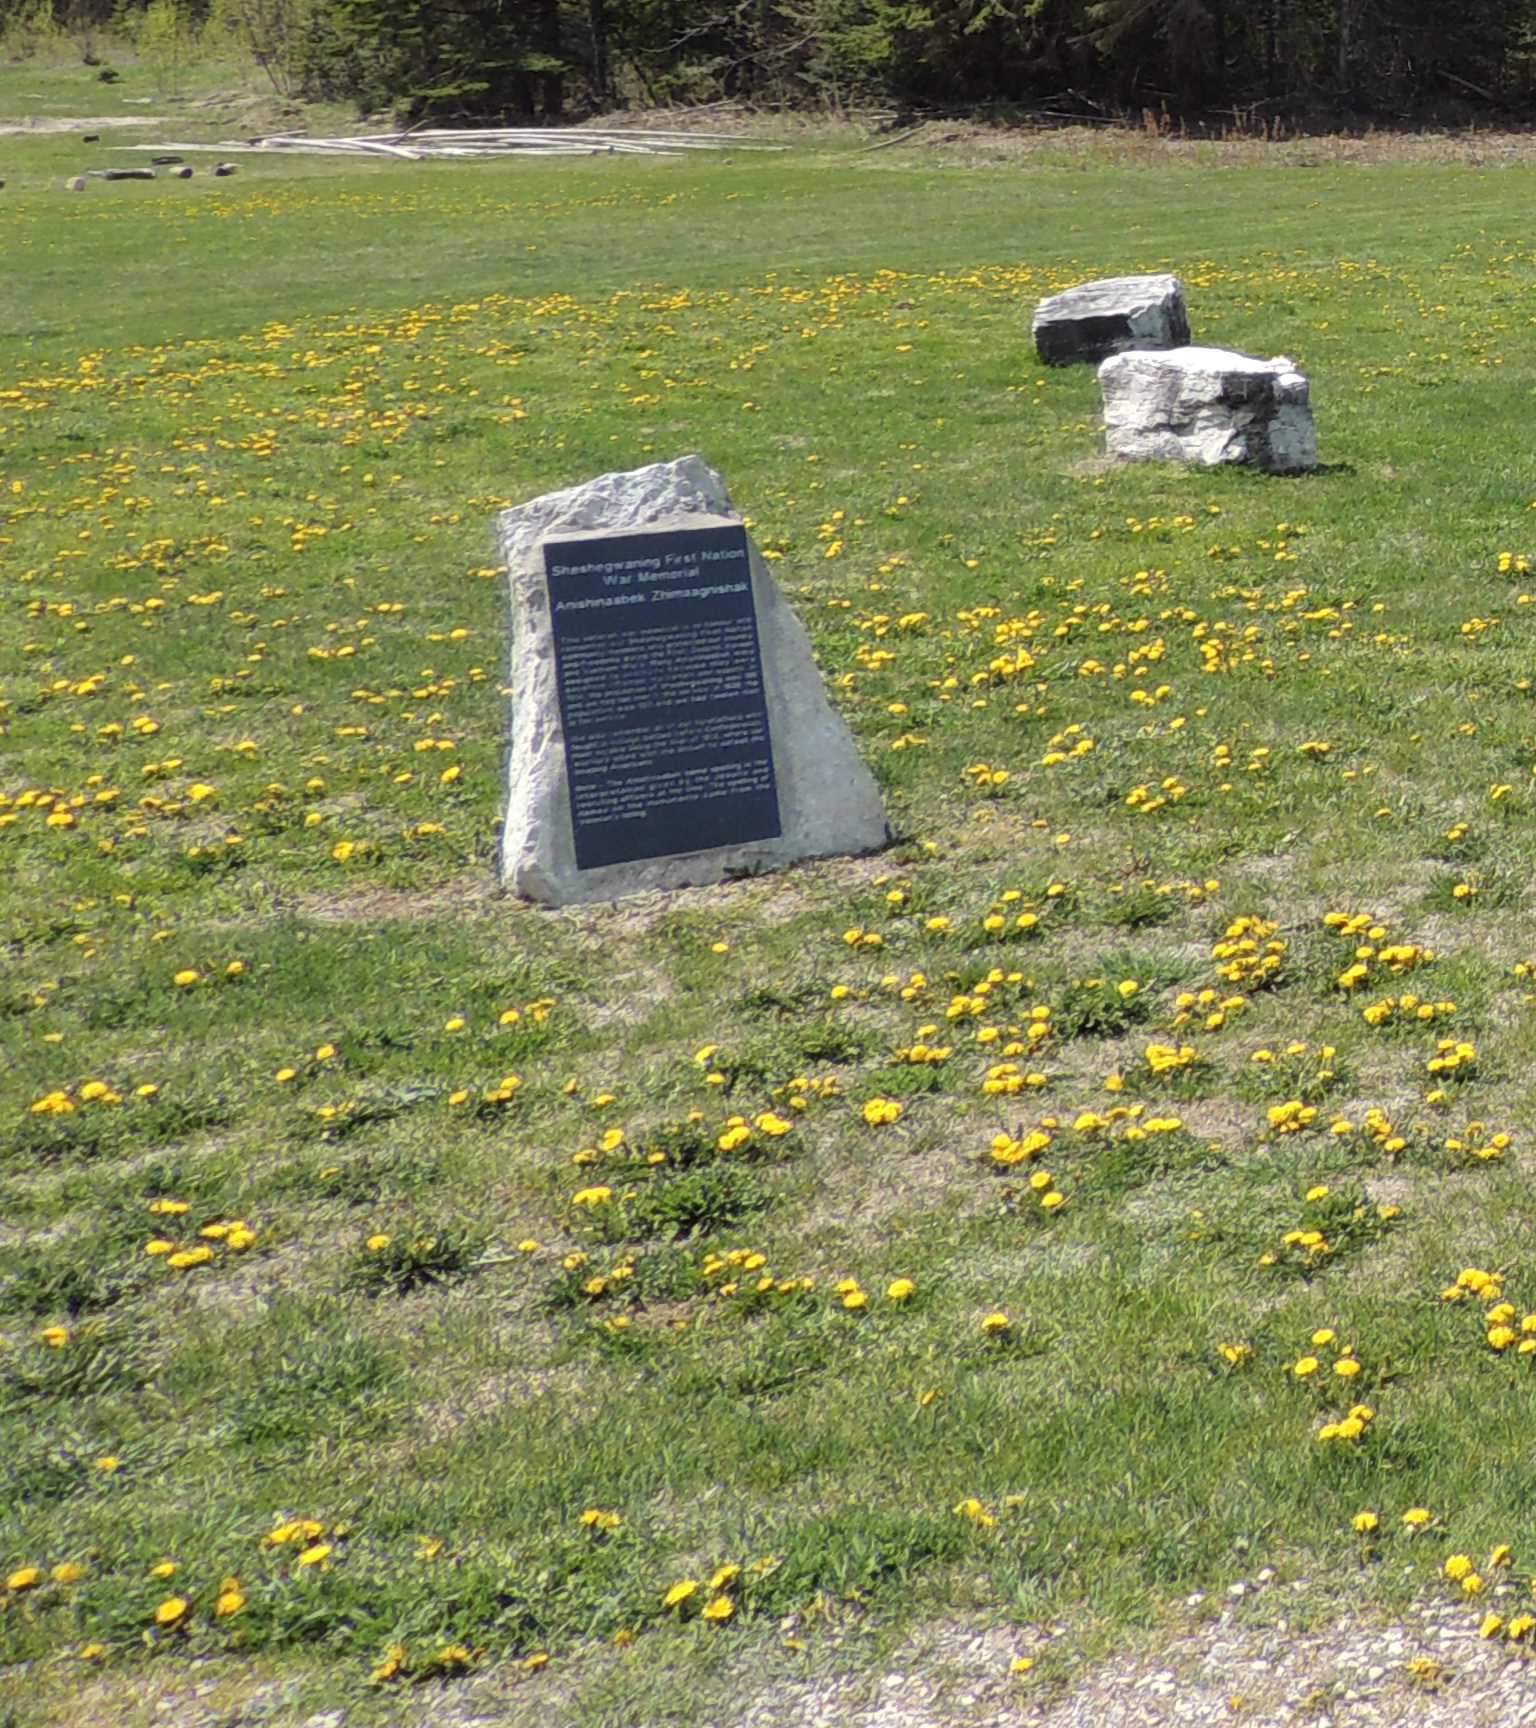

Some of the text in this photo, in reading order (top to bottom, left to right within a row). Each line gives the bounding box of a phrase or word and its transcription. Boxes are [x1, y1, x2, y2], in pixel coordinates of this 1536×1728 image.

[551, 548, 745, 577] Sheshegwaning First Nation
[603, 566, 700, 585] War Memorial
